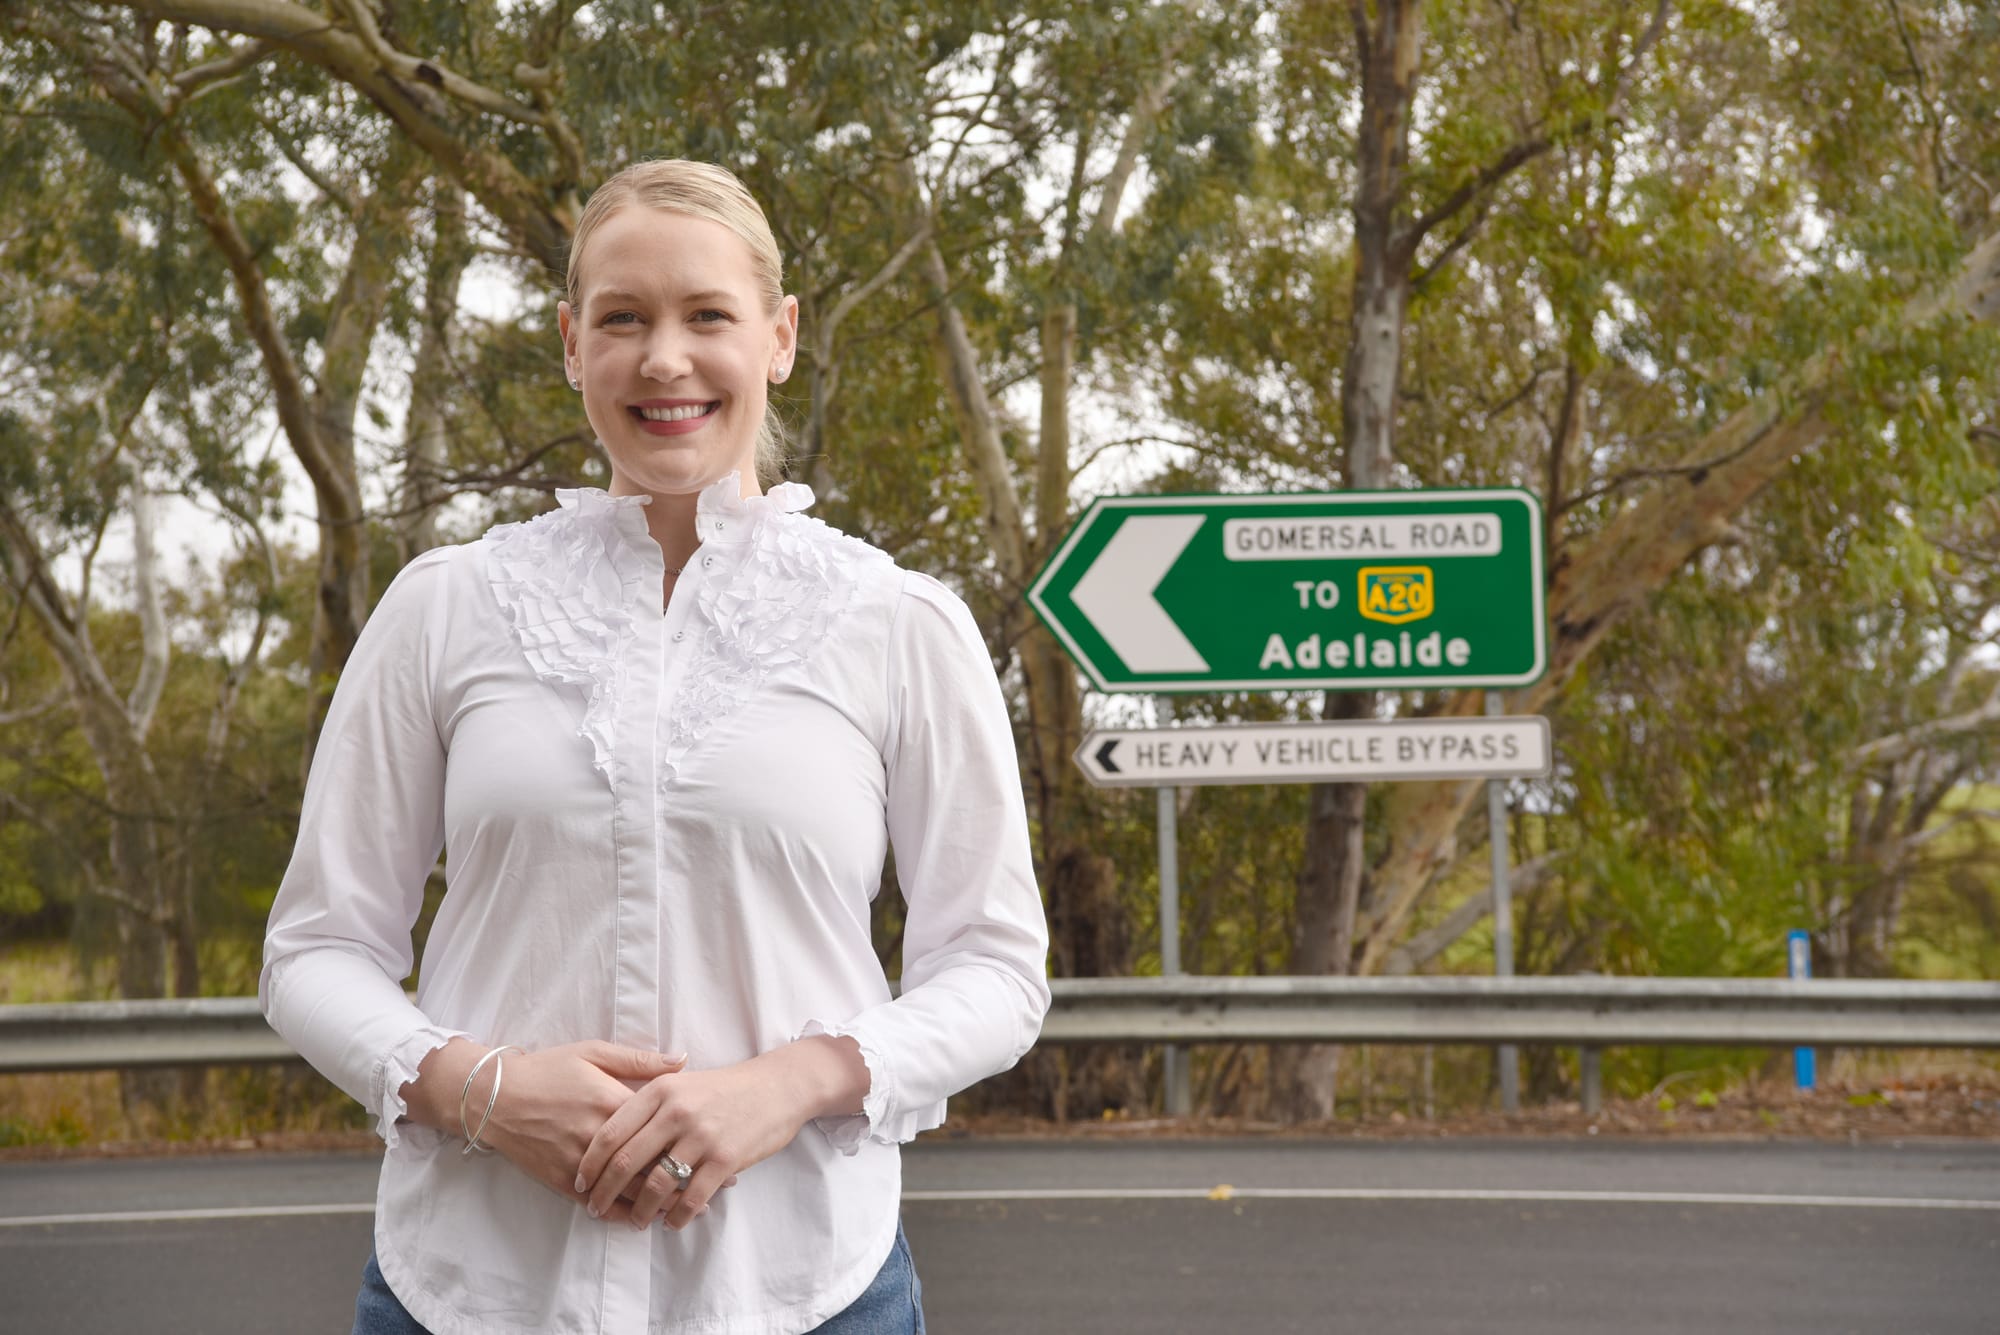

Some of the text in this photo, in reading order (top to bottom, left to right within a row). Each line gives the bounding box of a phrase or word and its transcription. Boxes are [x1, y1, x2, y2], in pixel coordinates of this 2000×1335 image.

[1236, 521, 1491, 552] GOMERSAL ROAD
[1293, 580, 1425, 611] TO A20
[1259, 631, 1472, 670] Adelaide
[1136, 734, 1520, 767] HEAVY VEHICLE BYPASS
